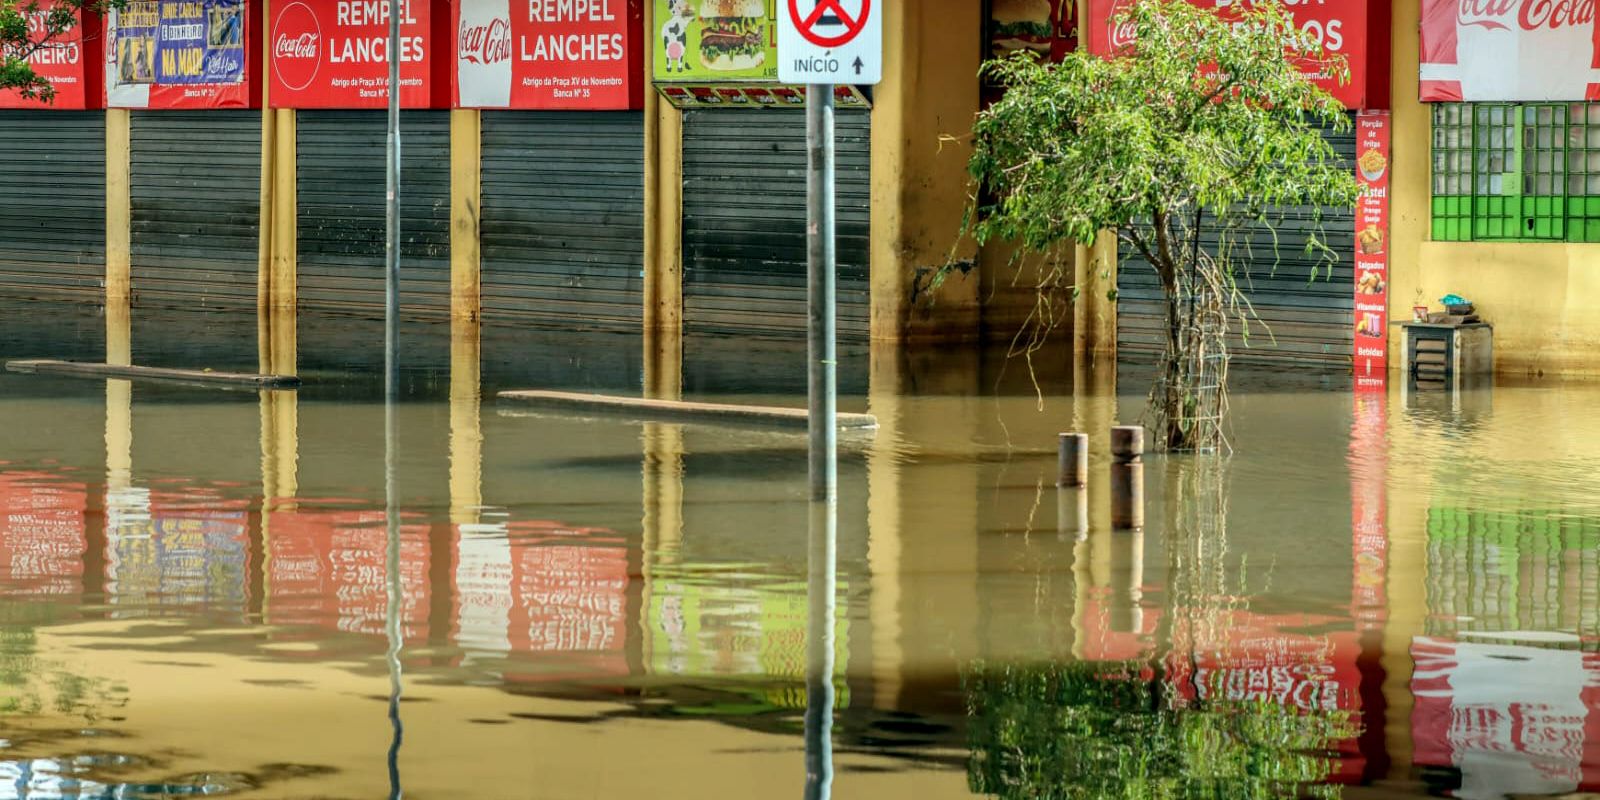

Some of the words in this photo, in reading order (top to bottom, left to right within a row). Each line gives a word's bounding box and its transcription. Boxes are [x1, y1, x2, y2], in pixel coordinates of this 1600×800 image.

[528, 0, 616, 22] REMPEL
[169, 25, 203, 39] DINHEIRO
[275, 32, 319, 58] Coca-Cola
[520, 34, 624, 61] LANCHES
[161, 48, 176, 76] NA
[331, 78, 350, 88] Abrigo
[359, 78, 375, 88] Praça
[376, 78, 384, 86] XV
[398, 78, 423, 86] ovembro
[522, 77, 543, 88] Abrigo
[544, 77, 551, 86] da
[552, 77, 570, 88] Praça
[571, 77, 580, 86] XV
[582, 77, 589, 86] de
[590, 77, 622, 86] Novembro
[359, 89, 377, 97] Banca
[554, 88, 573, 97] Banca
[582, 88, 590, 97] 35
[1358, 261, 1385, 271] Salgados
[1356, 303, 1385, 312] Vitaminas
[1358, 347, 1383, 356] Bebidas
